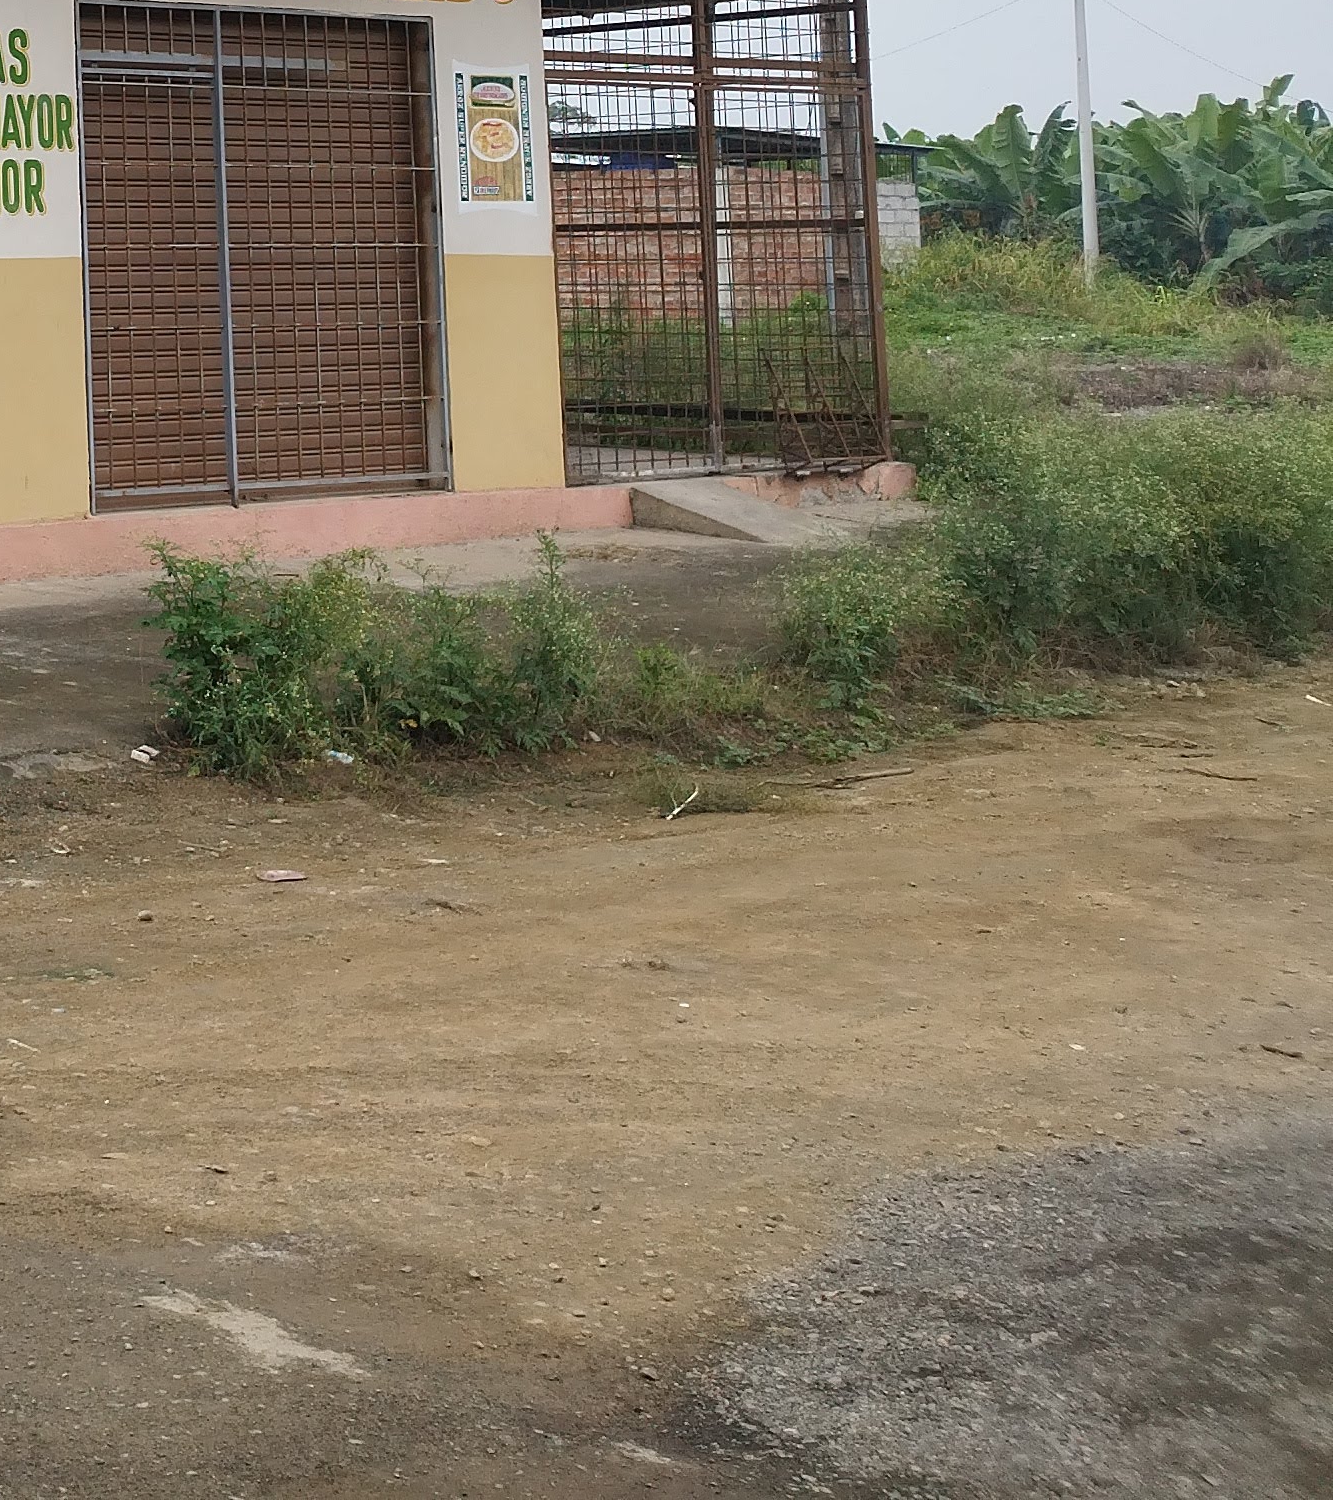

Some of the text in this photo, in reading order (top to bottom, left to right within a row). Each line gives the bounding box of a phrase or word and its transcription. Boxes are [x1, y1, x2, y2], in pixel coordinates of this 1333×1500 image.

[455, 76, 469, 199] ARROZ SUPER RENDIDOR
